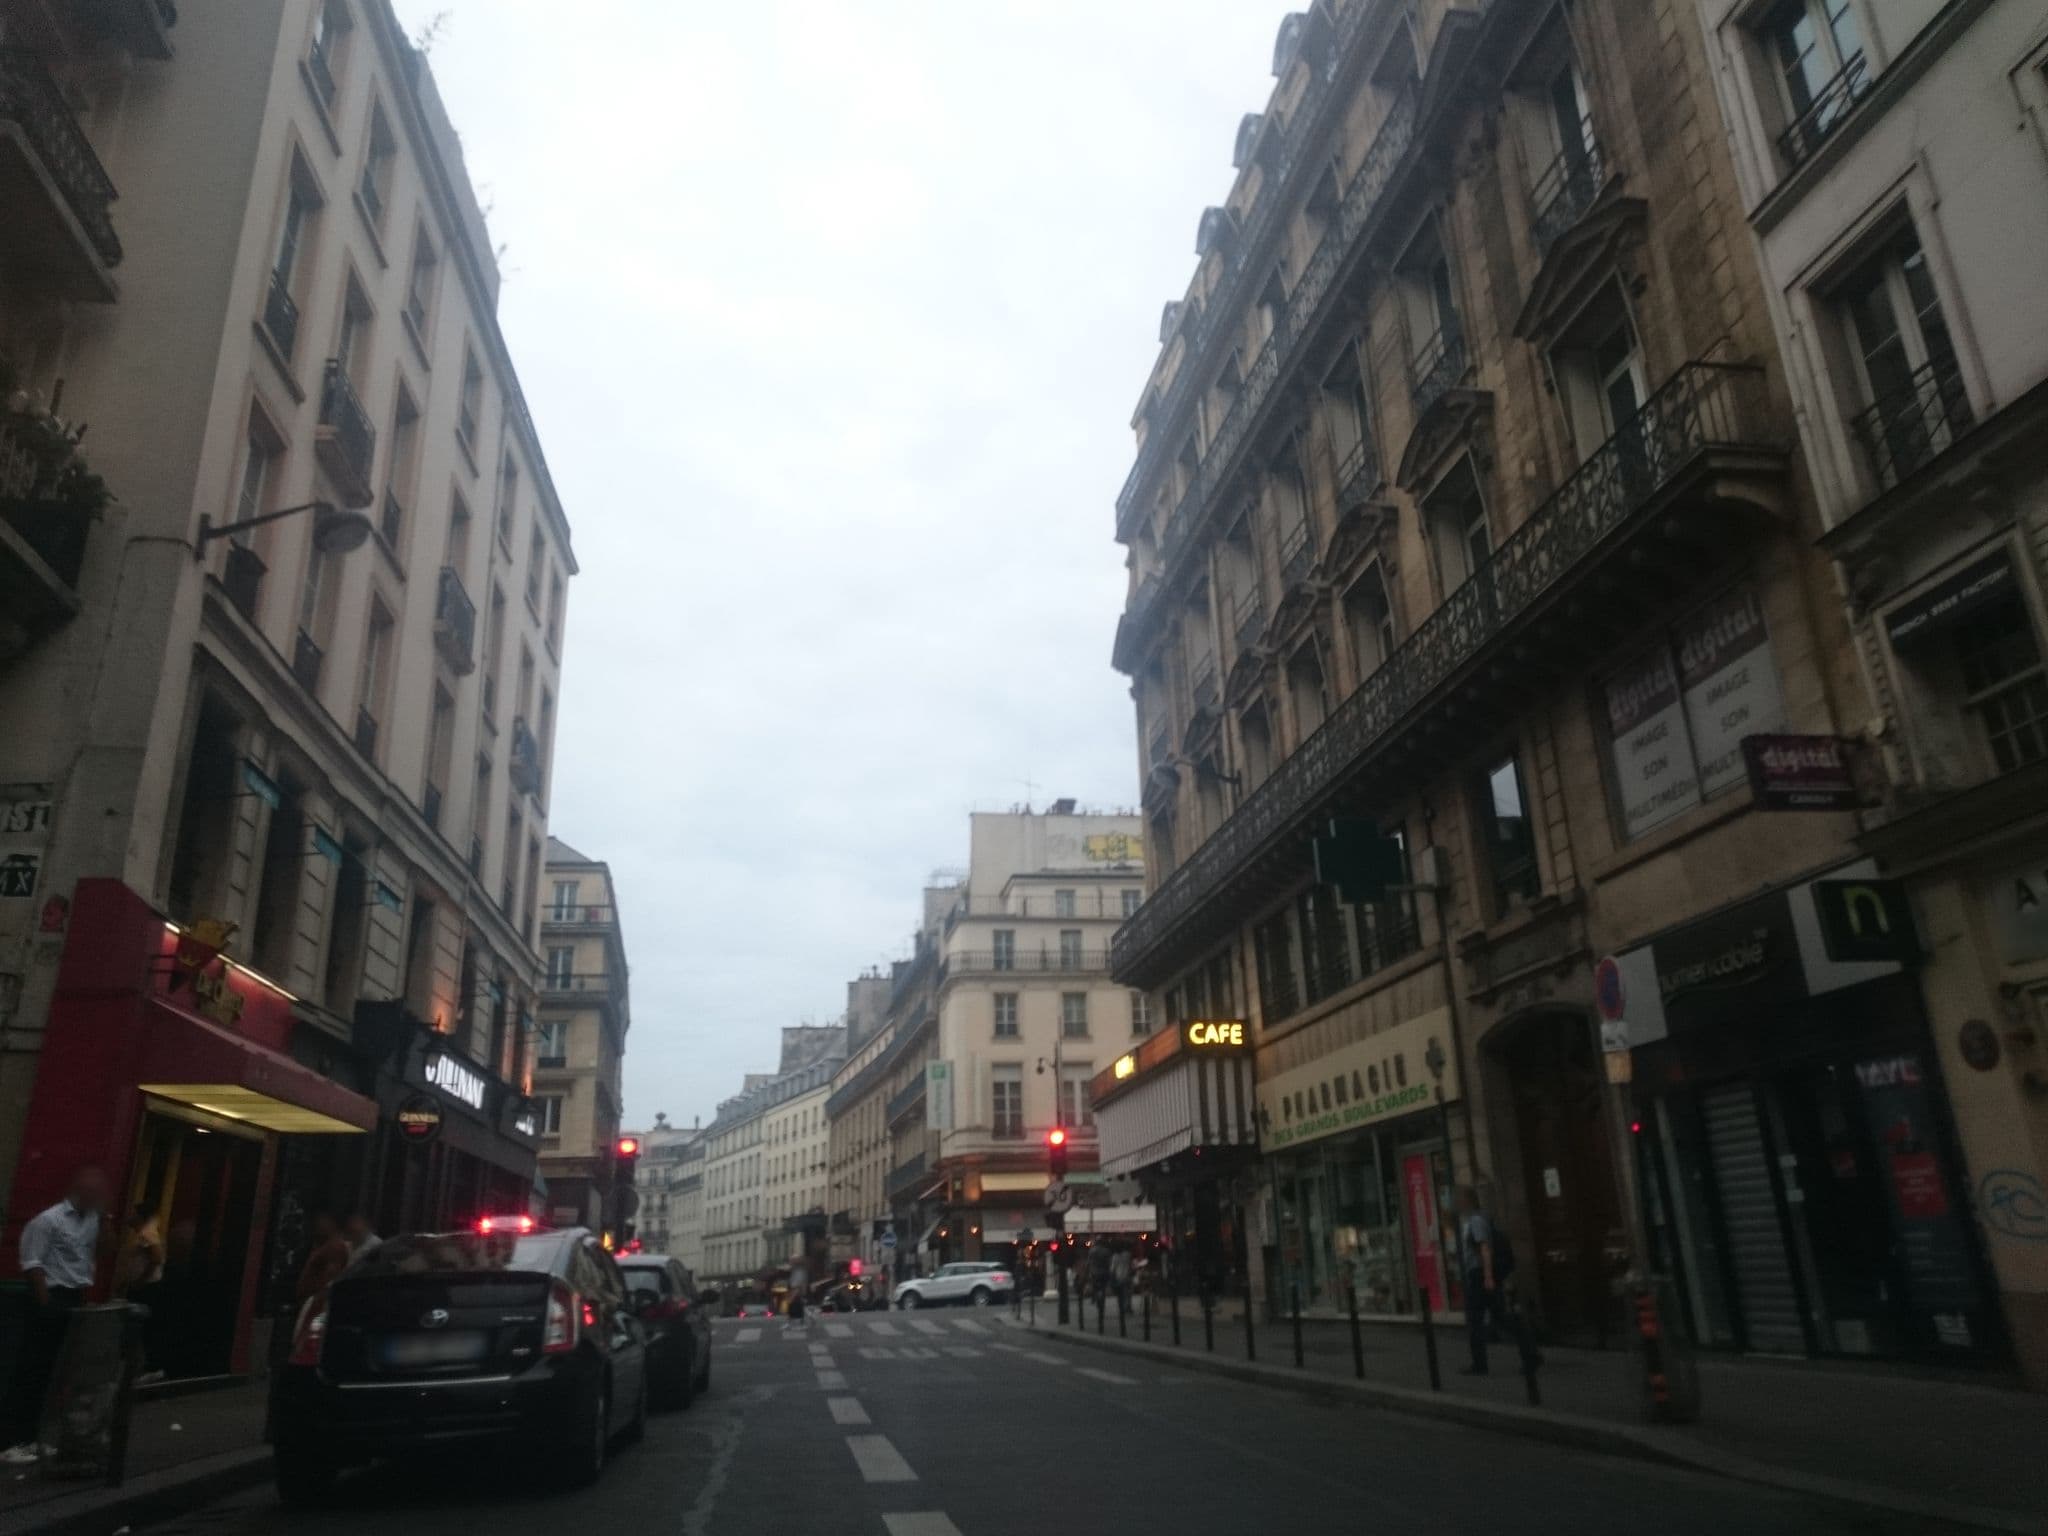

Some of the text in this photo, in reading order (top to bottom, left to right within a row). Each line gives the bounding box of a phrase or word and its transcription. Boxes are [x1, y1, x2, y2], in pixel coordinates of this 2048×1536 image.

[1679, 592, 1760, 671] digital
[1605, 647, 1681, 723] digital
[1720, 708, 1749, 733] SON
[1643, 755, 1669, 780] SON
[1761, 742, 1842, 774] digital
[1188, 1022, 1244, 1046] CAFE
[1282, 1053, 1407, 1123] PHARMACIE
[1295, 1112, 1340, 1138] GRANDS
[1343, 1084, 1429, 1124] BOULEVARDS
